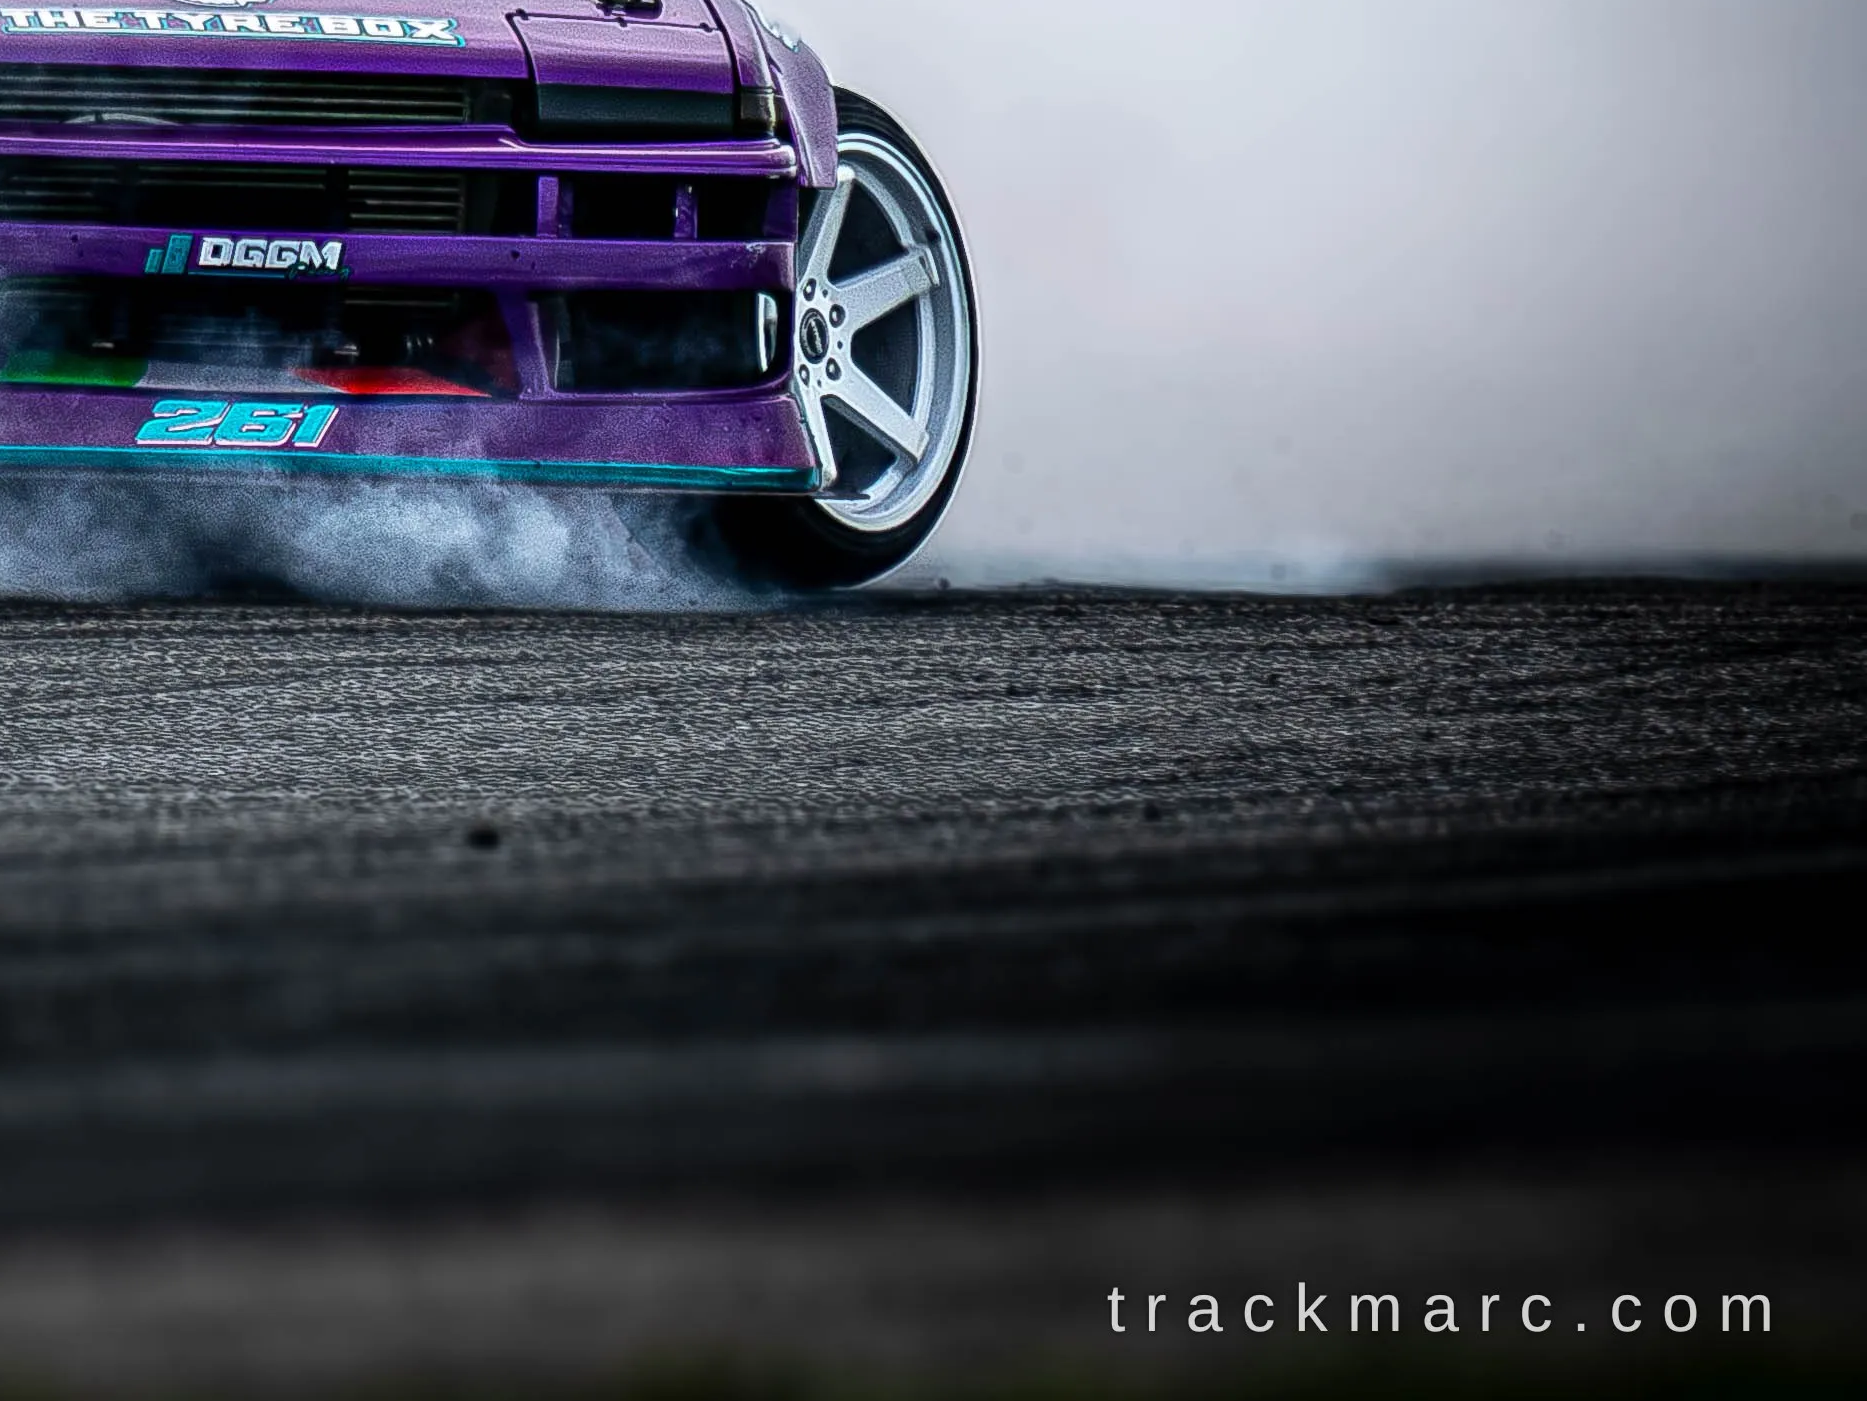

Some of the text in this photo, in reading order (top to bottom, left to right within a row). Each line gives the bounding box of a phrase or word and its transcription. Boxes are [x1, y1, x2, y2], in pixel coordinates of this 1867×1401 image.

[3, 7, 459, 42] THE TYRE BOX
[198, 236, 342, 270] DGGM
[135, 400, 339, 448] 261
